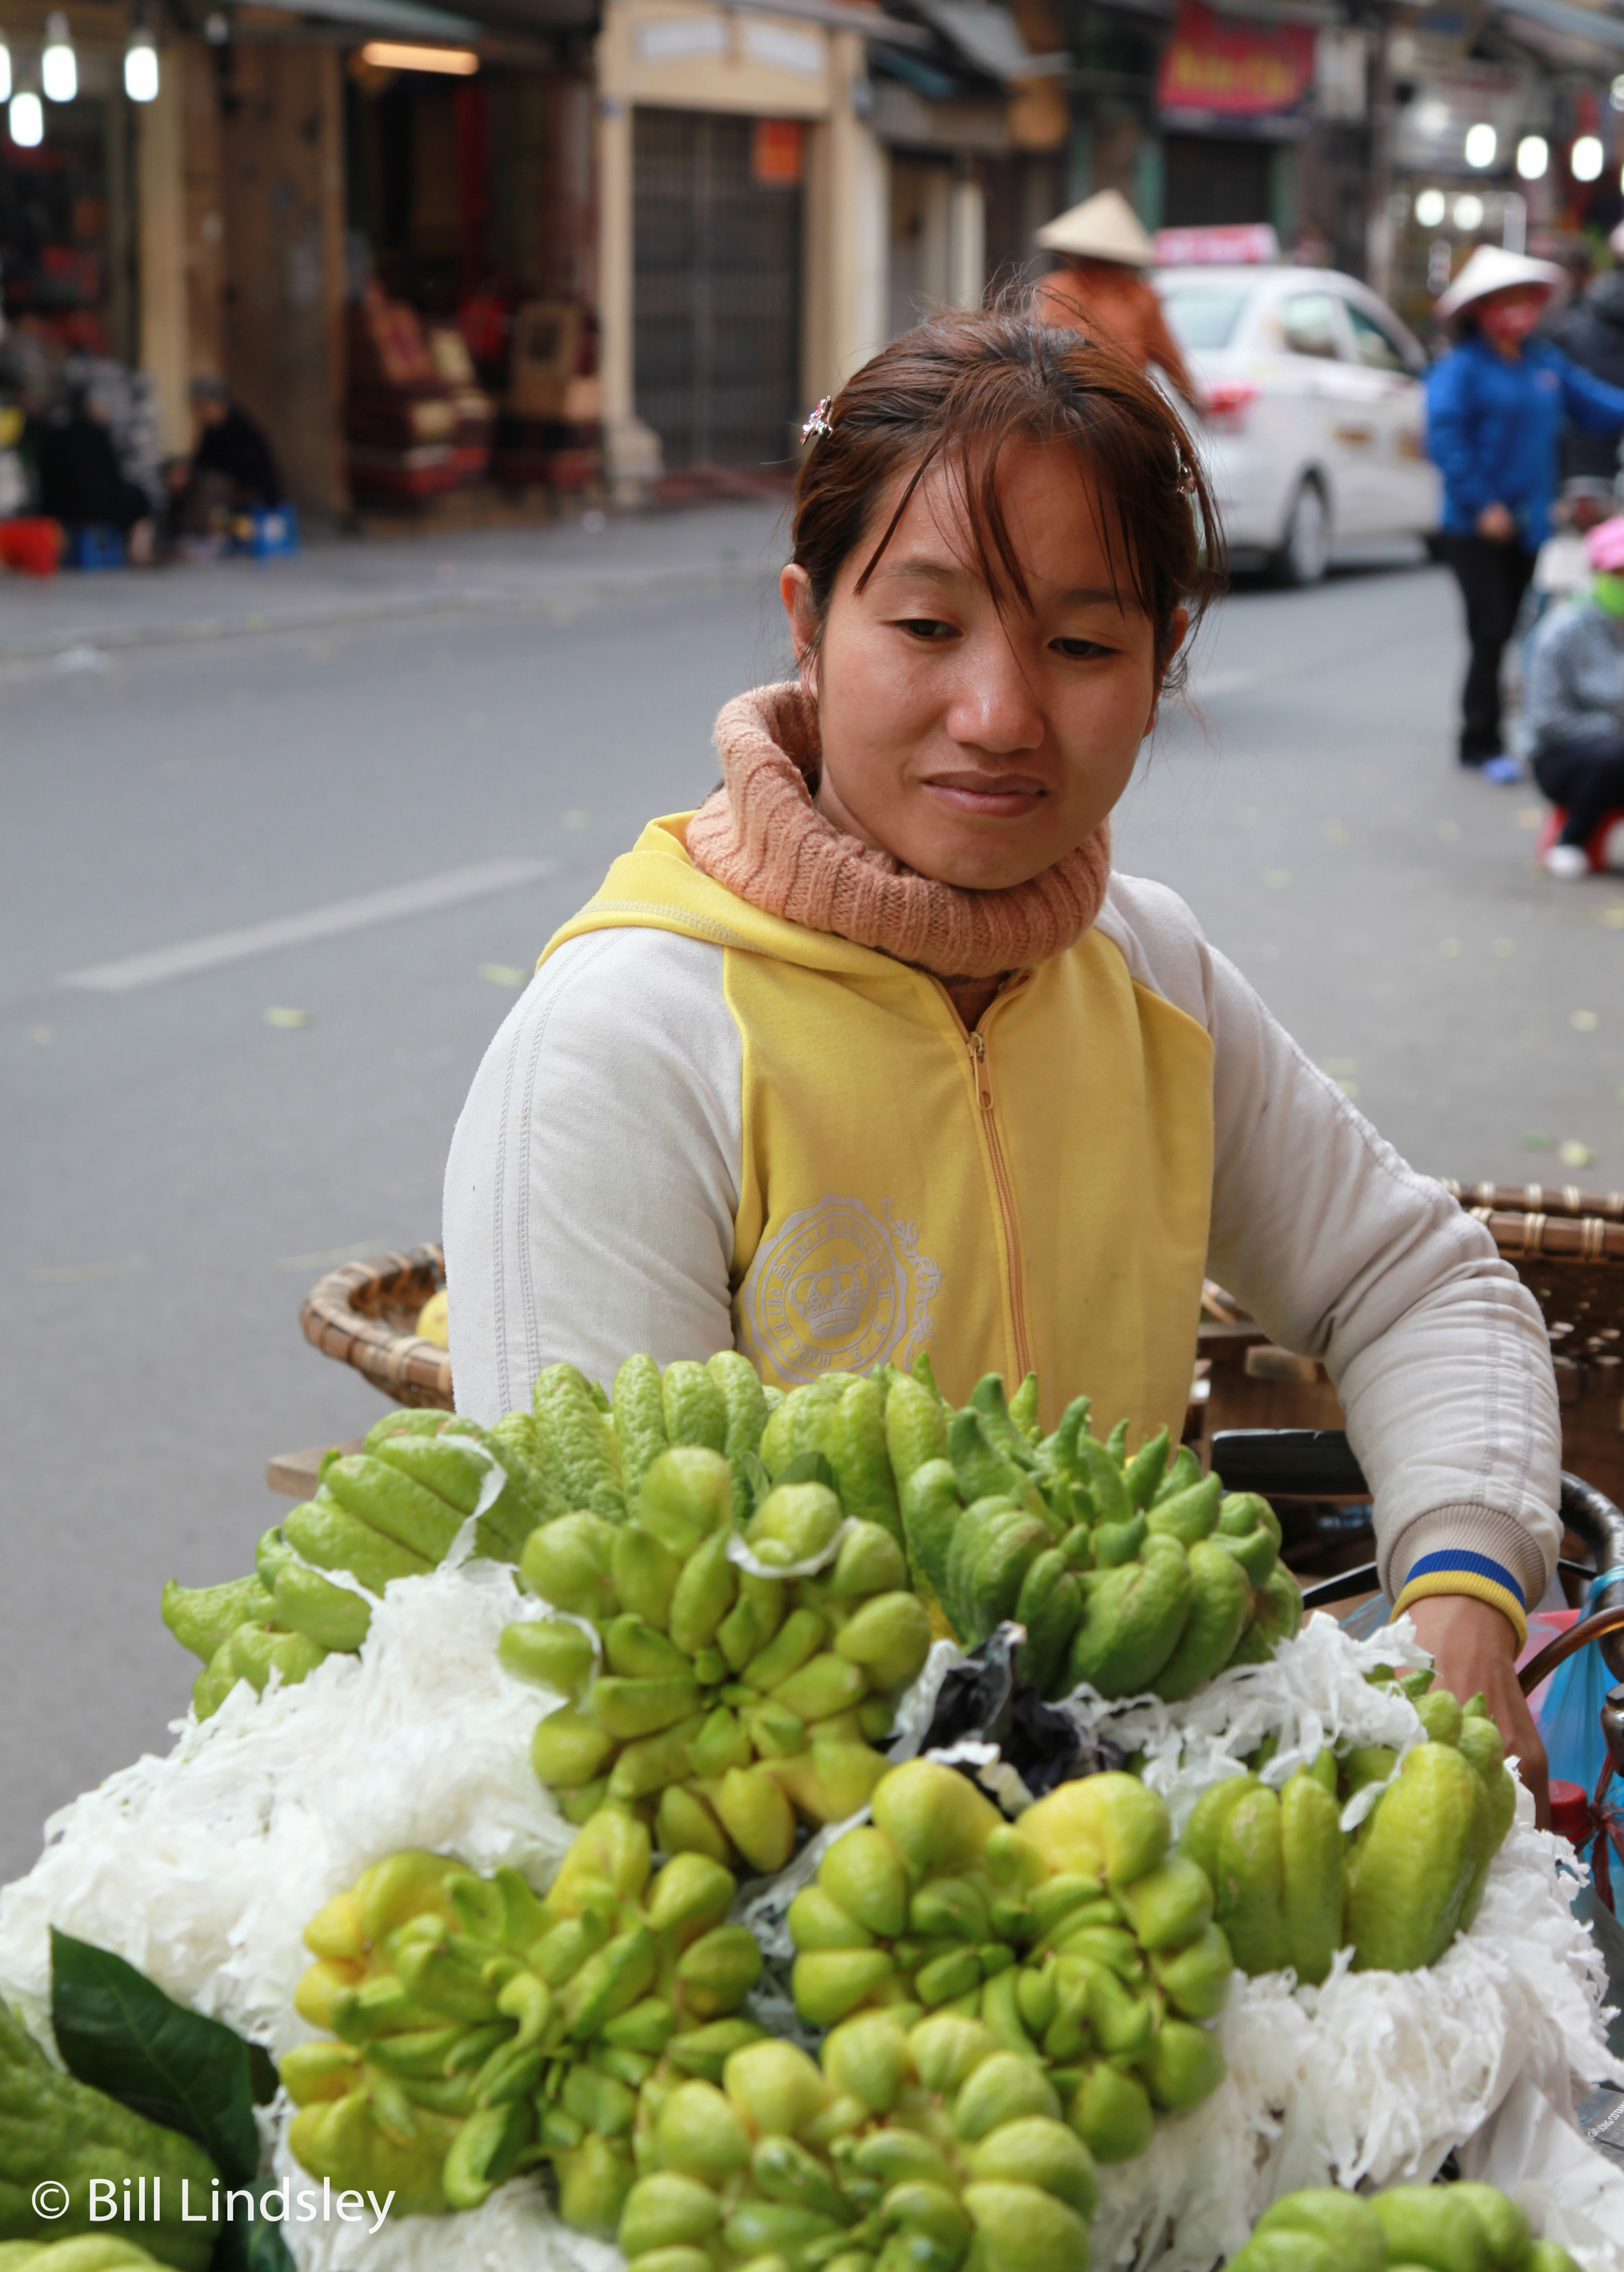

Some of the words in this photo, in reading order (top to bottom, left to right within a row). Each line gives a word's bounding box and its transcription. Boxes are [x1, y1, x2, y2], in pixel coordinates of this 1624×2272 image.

[772, 1227, 822, 1282] Super
[825, 1215, 887, 1279] Glamorous
[765, 1287, 781, 1315] the
[774, 1322, 789, 1340] in
